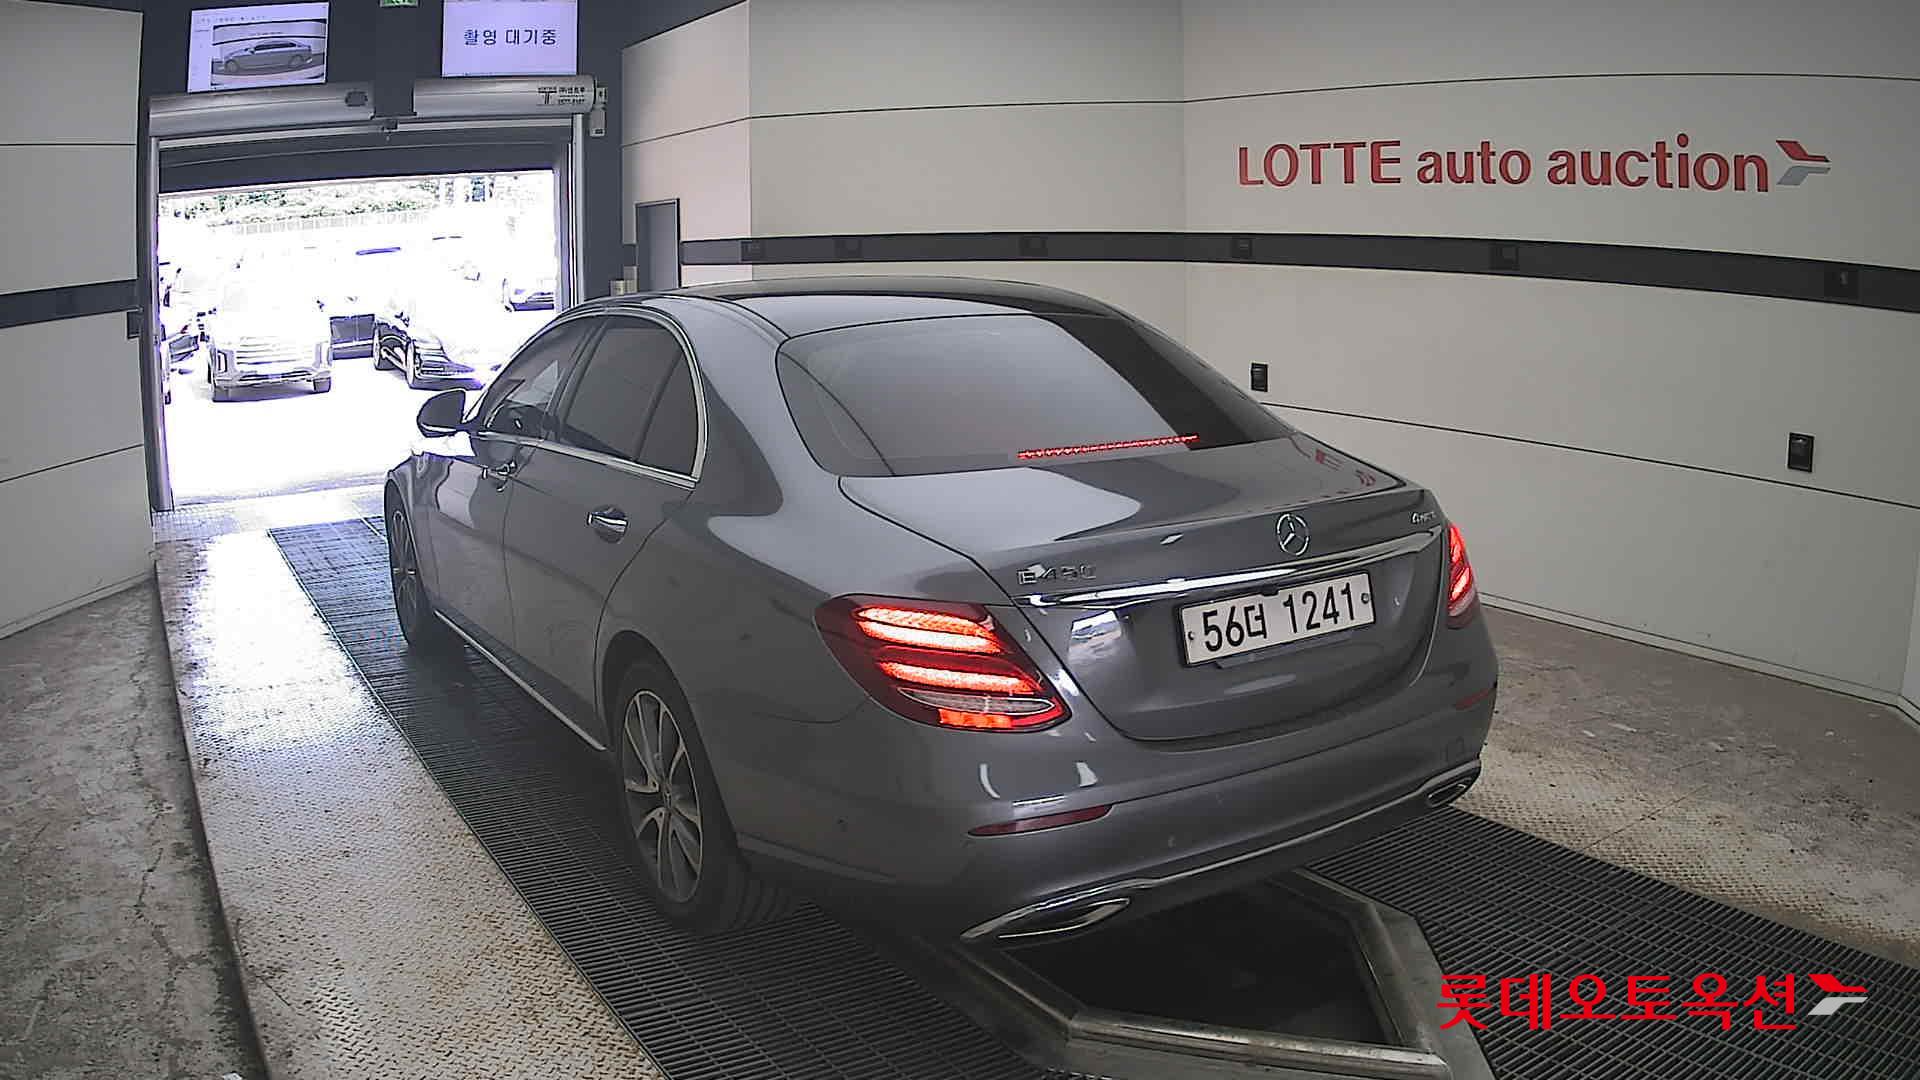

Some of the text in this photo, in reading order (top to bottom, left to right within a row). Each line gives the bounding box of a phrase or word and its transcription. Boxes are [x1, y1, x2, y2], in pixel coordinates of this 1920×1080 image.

[464, 29, 557, 46] 촬영 대기중
[1239, 133, 1768, 193] LOTTE auto auction
[1202, 582, 1355, 652] 56더 1241
